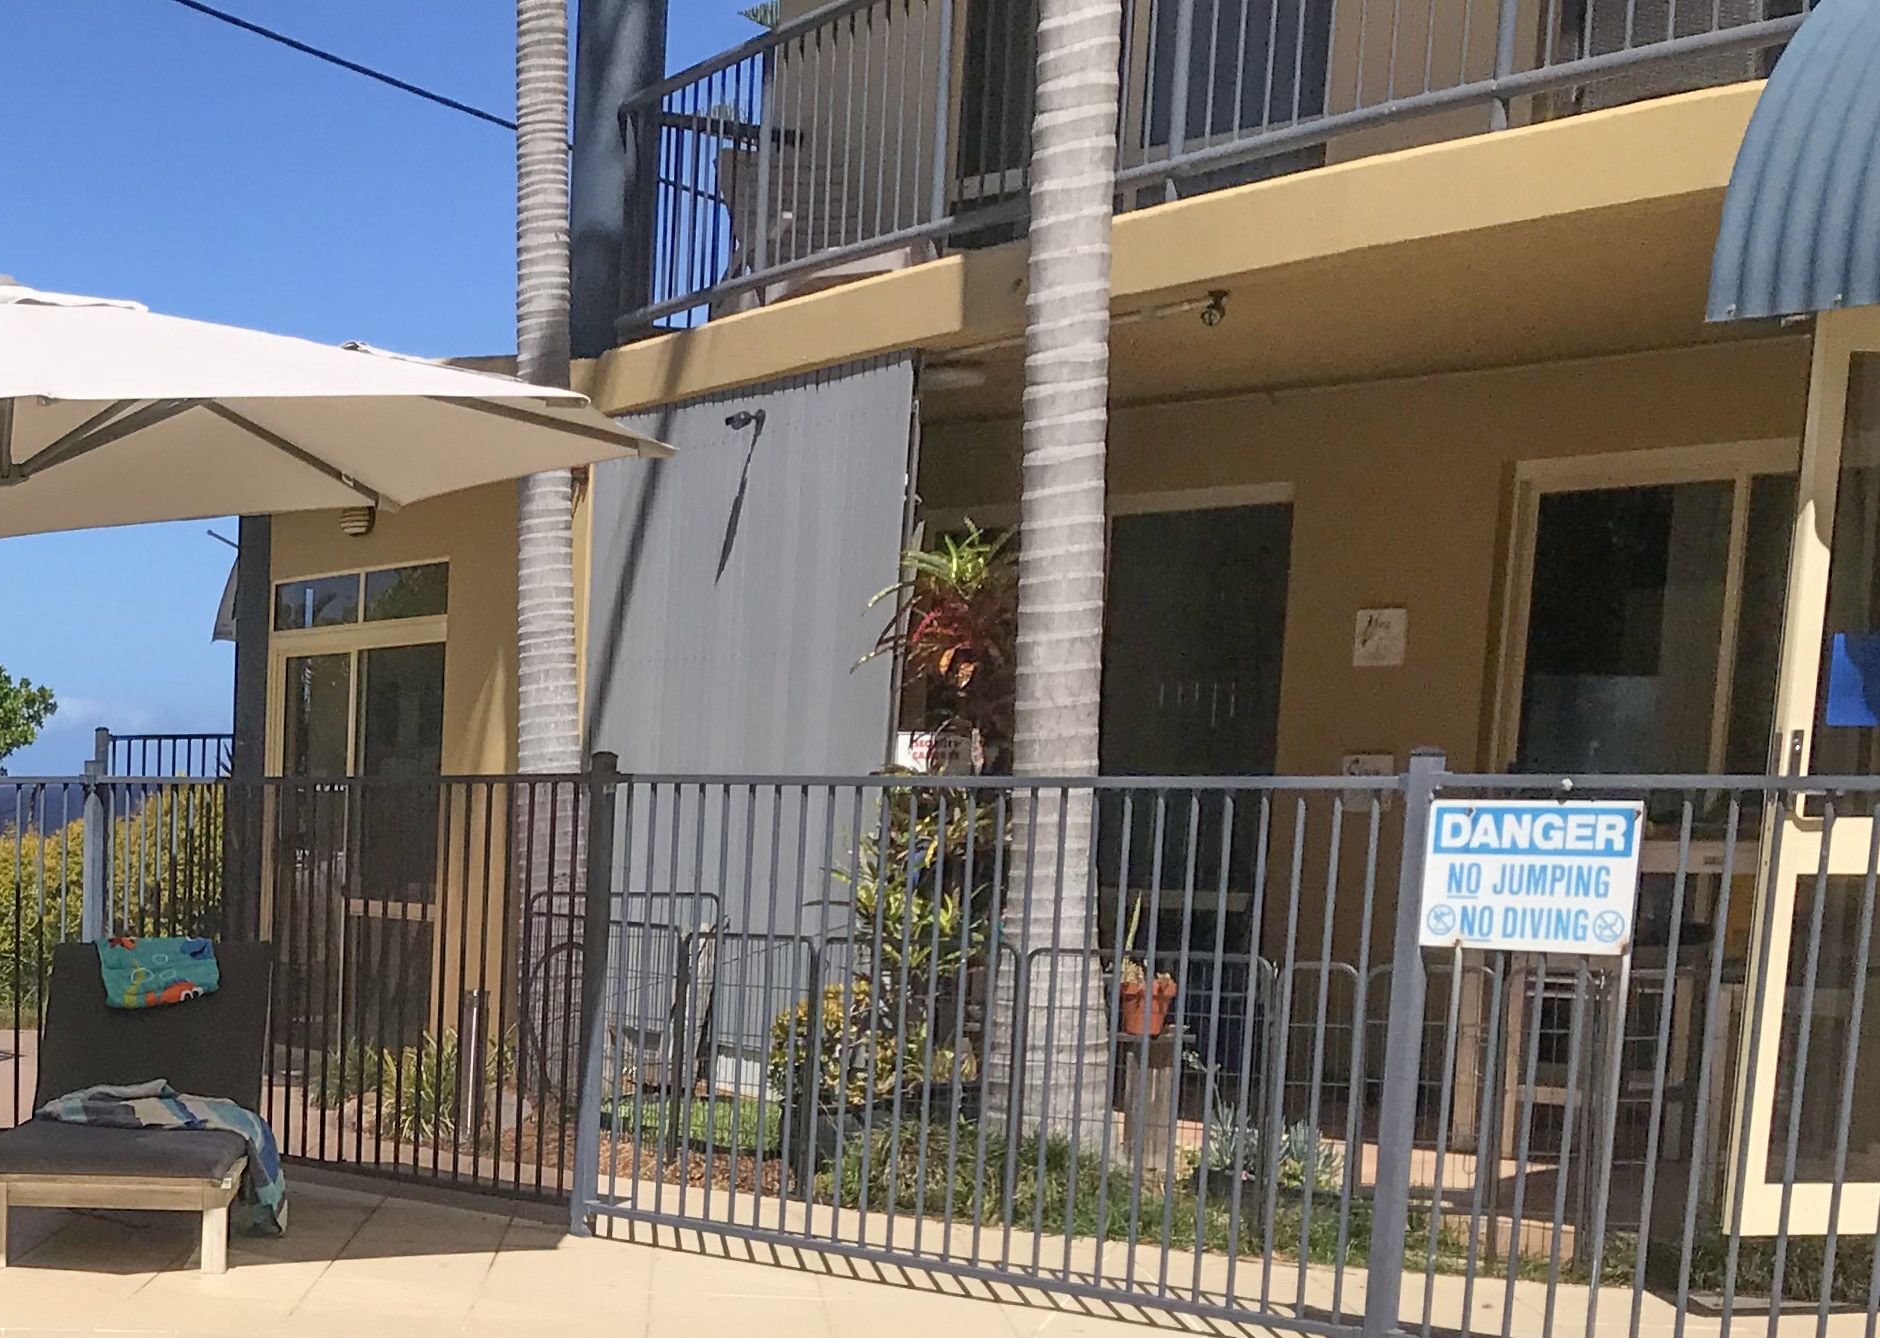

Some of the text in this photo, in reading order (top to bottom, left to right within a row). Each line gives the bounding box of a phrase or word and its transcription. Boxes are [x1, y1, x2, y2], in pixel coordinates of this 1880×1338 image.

[1439, 811, 1628, 852] DANGER
[1446, 861, 1612, 899] NO JUMPING
[1459, 904, 1590, 942] NO DIVING
